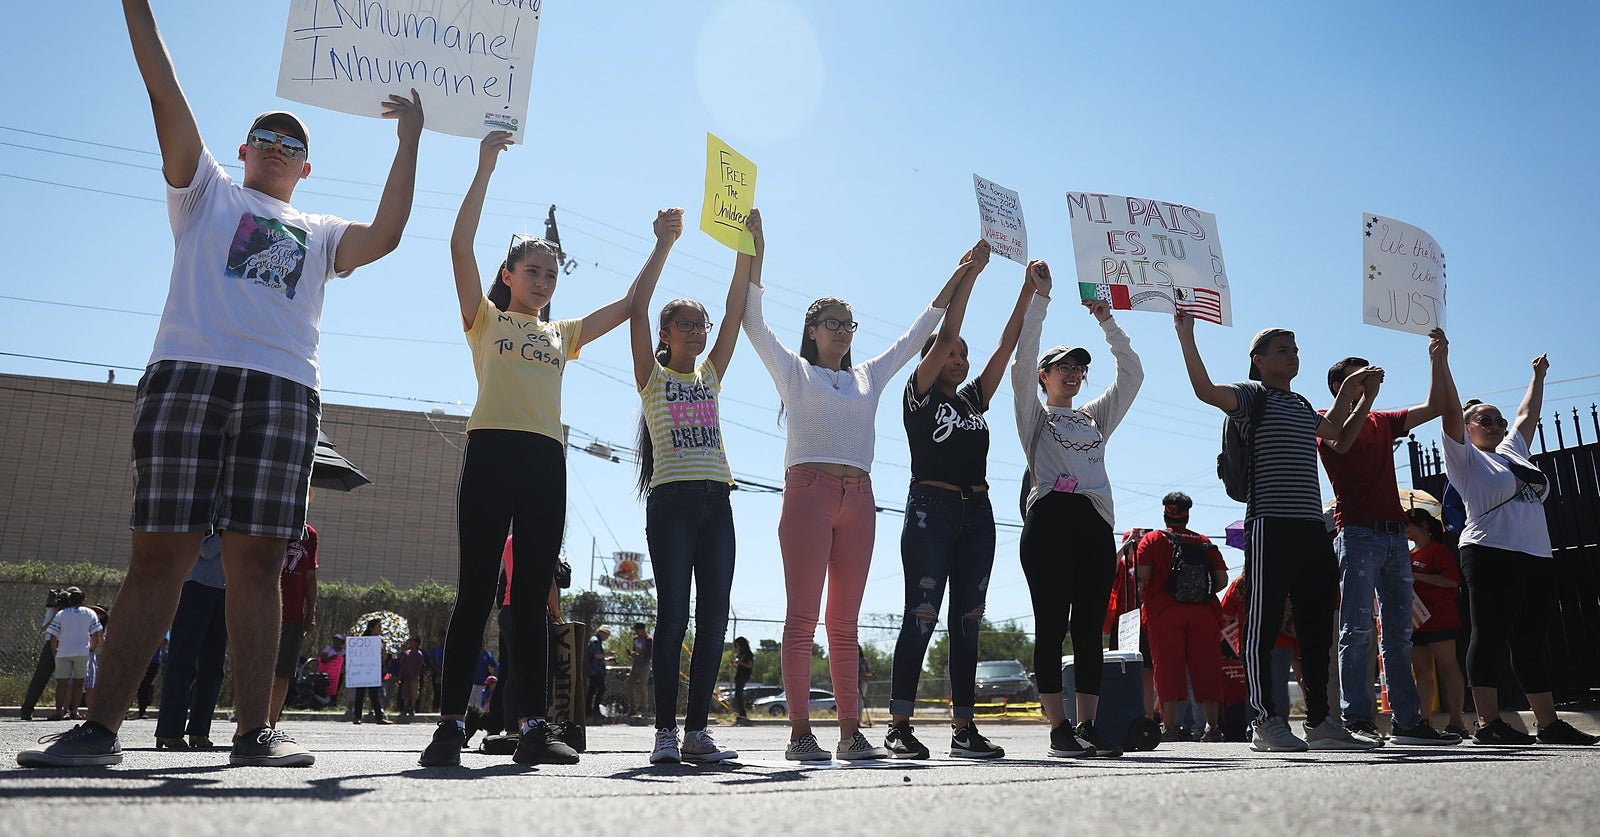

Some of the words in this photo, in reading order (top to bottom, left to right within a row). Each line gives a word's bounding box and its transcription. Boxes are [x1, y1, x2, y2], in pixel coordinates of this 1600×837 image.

[719, 150, 748, 186] FREE
[976, 179, 987, 190] You
[1066, 193, 1112, 224] MI
[984, 226, 1008, 241] WHERE
[1107, 230, 1147, 256] ES
[1152, 234, 1186, 260] TU
[1380, 224, 1407, 255] We
[1377, 289, 1439, 325] JUST
[494, 338, 514, 355] Tu
[520, 342, 561, 370] Casa
[526, 333, 551, 348] es
[616, 552, 643, 562] THE
[348, 638, 372, 647] GOD
